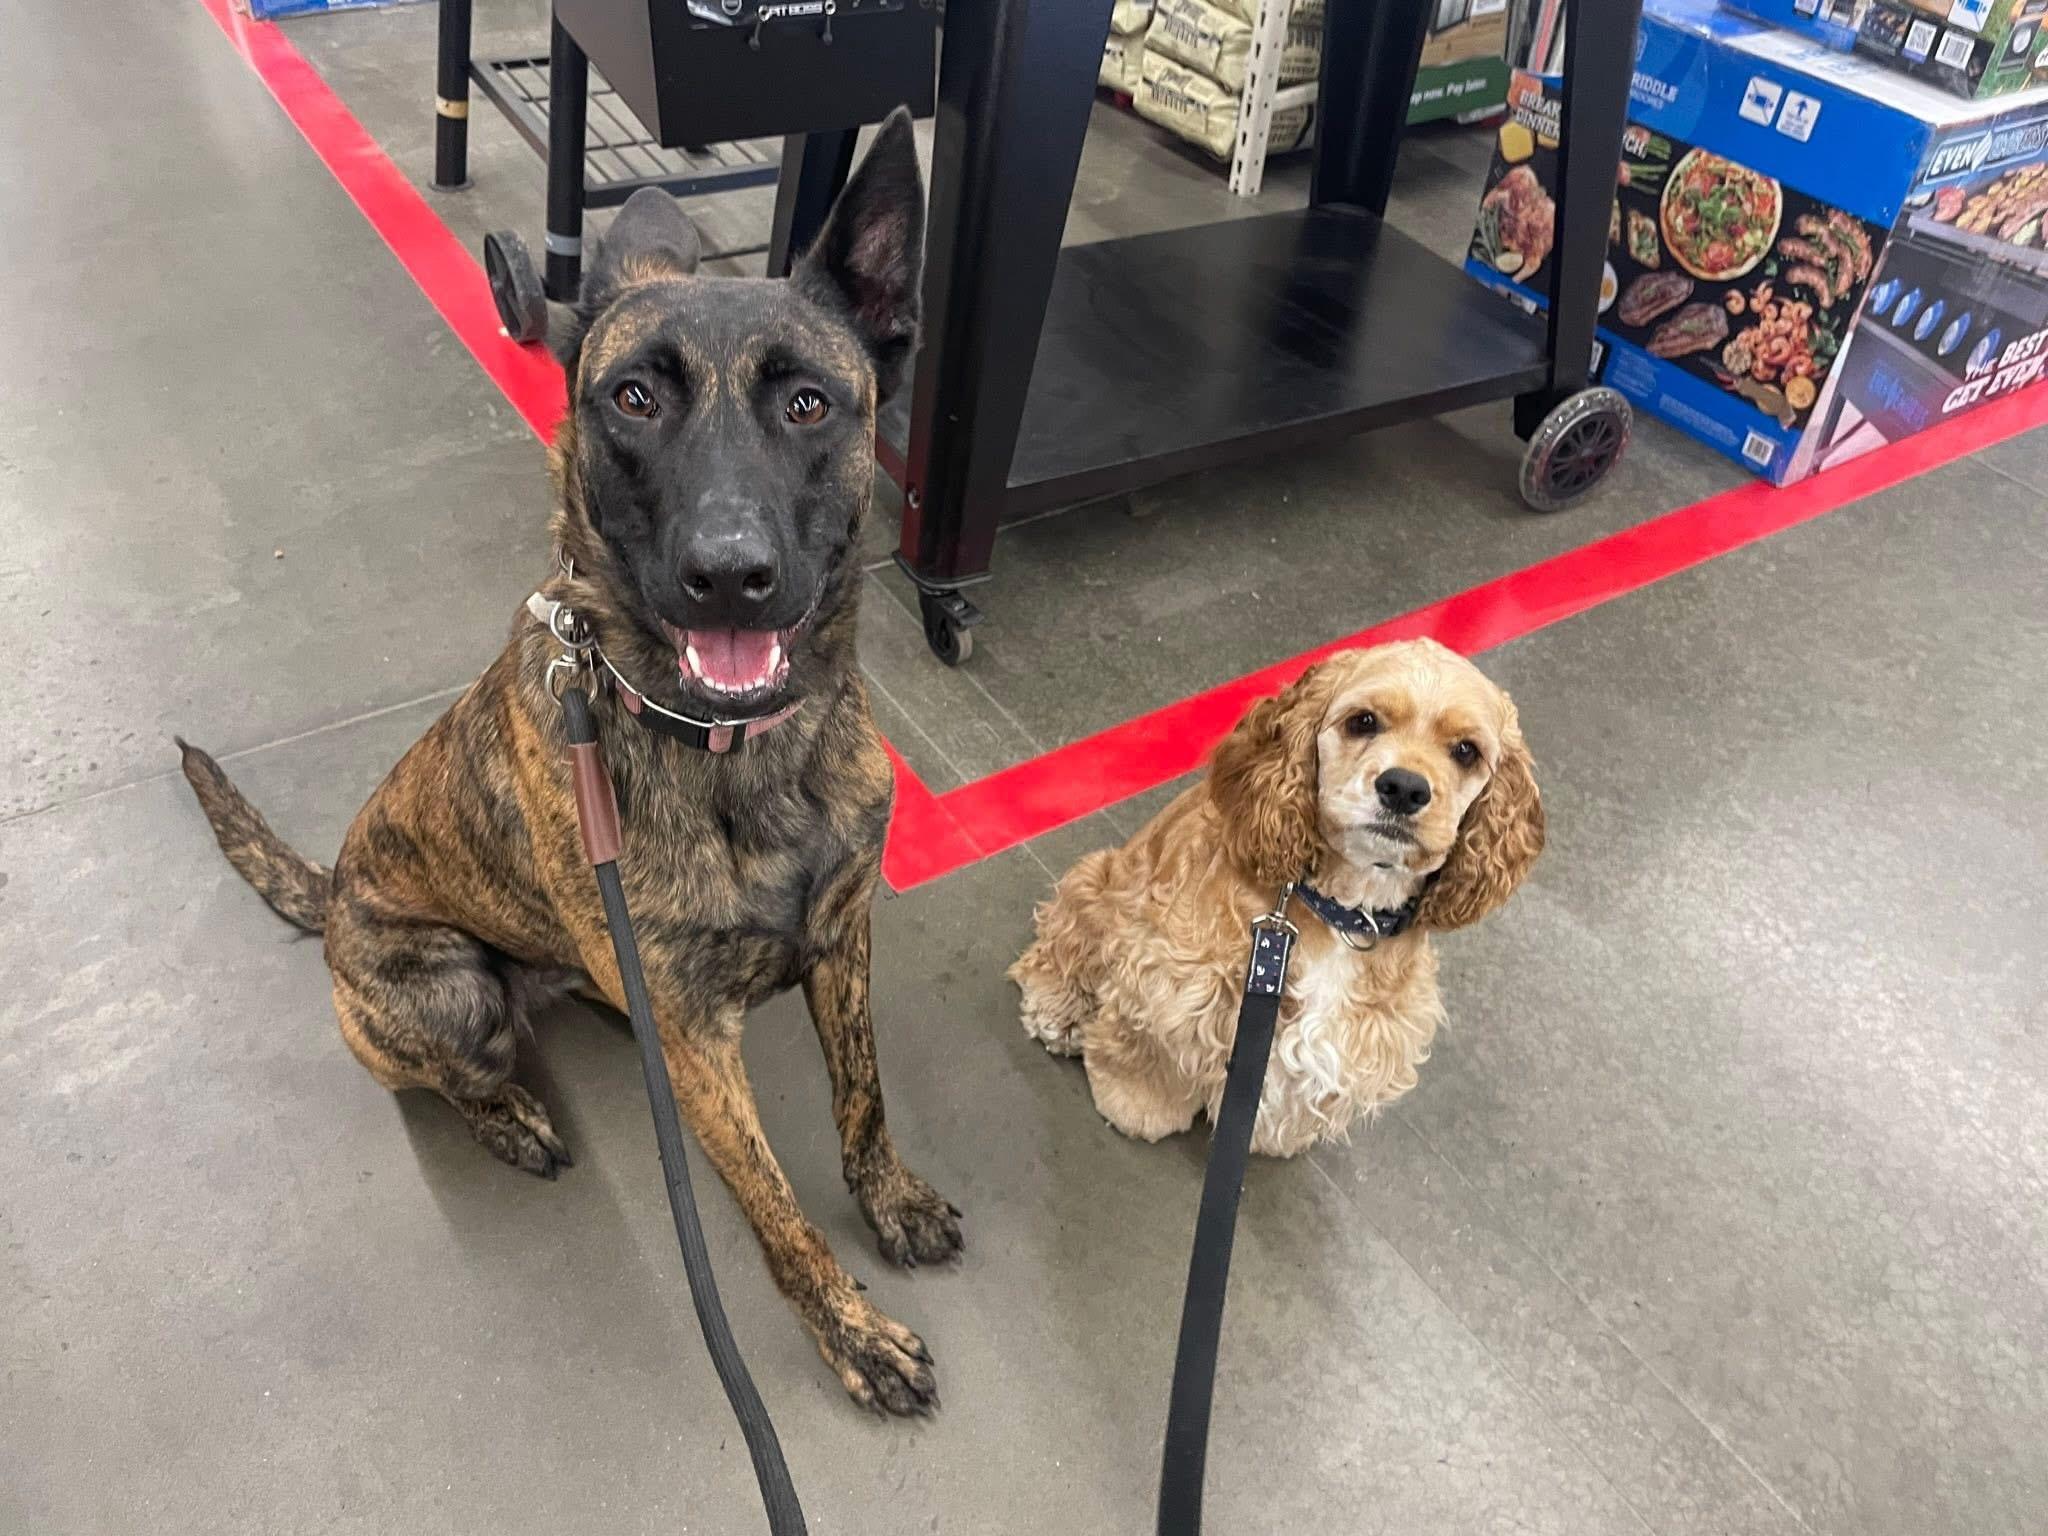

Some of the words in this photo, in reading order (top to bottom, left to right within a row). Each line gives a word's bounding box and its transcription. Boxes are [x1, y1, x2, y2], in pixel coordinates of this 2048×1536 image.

[1930, 141, 1977, 177] EVEN
[1964, 357, 1998, 383] THE
[1997, 329, 2048, 369] BEST
[1941, 375, 1991, 414] GET
